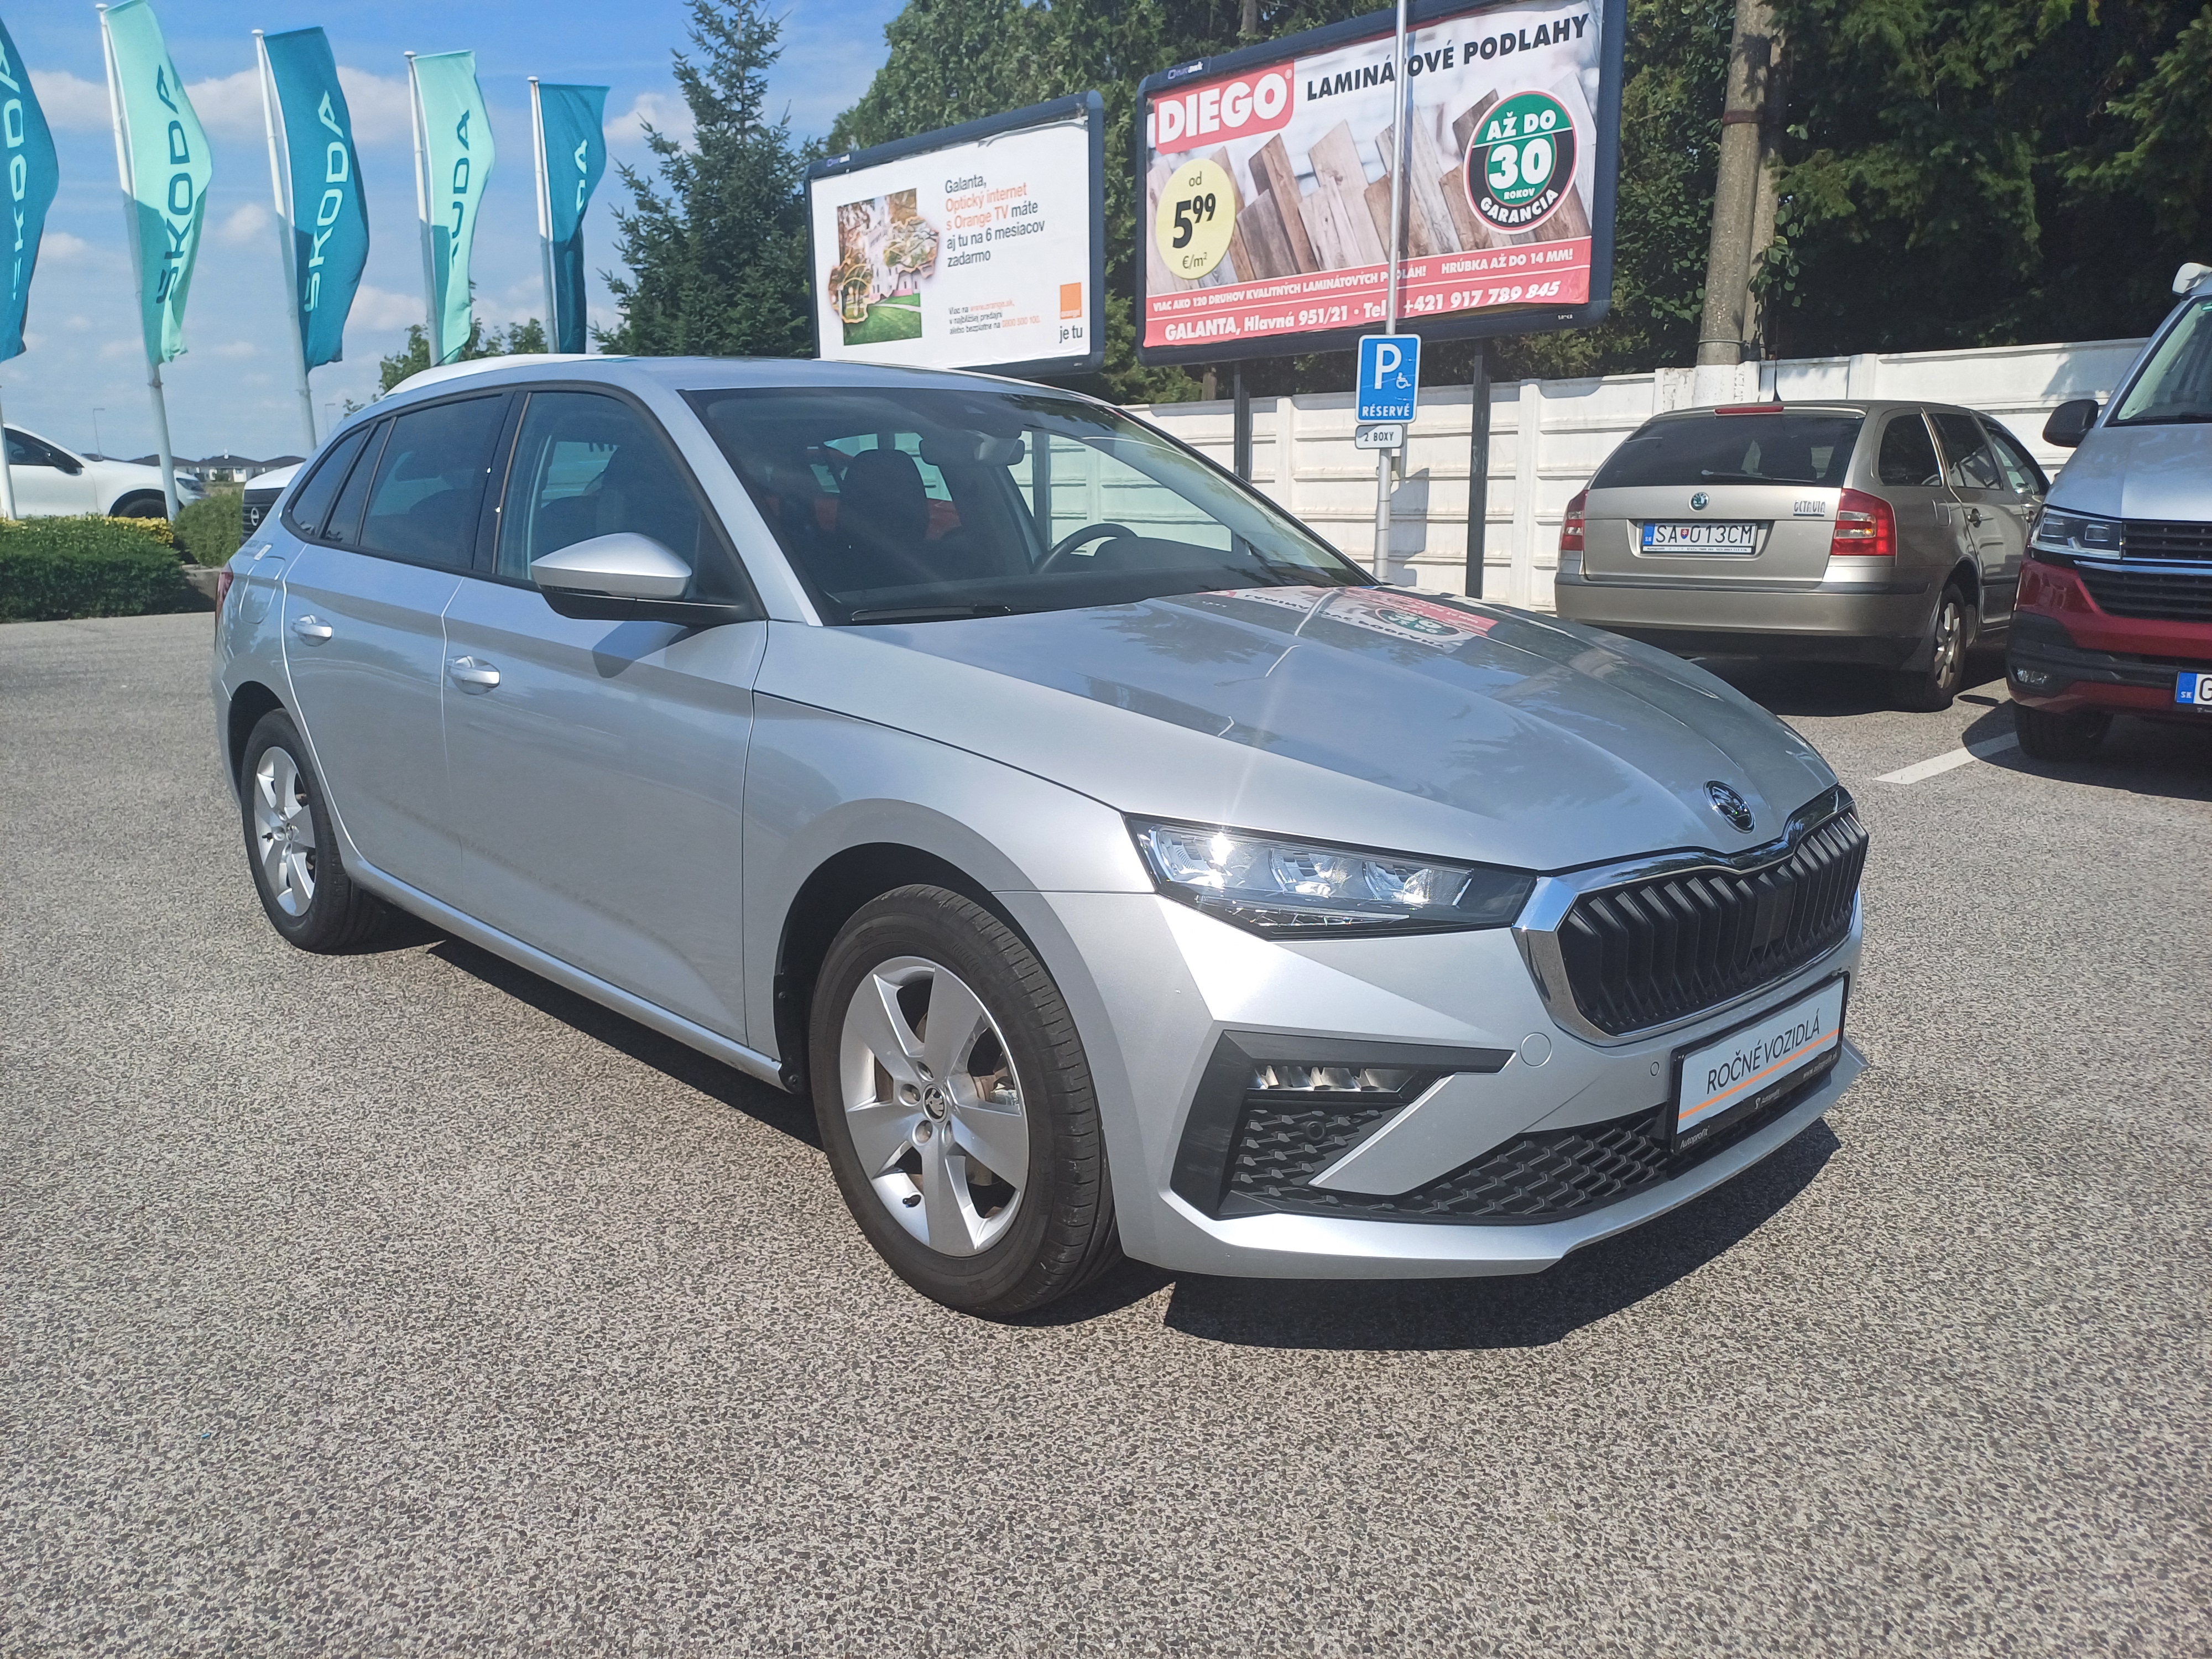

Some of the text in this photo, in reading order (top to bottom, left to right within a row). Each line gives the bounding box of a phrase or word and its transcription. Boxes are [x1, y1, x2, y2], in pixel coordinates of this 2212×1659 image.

[1307, 13, 1589, 101] LAMINÁOVÉ PODLAHY
[1158, 72, 1288, 144] DIEGO
[1486, 109, 1557, 141] AŽ DO
[1188, 170, 1202, 187] od
[1489, 138, 1552, 189] 30
[945, 174, 987, 194] Galanta,
[946, 182, 1027, 214] Optický internet
[1504, 187, 1536, 200] ROKOV
[946, 200, 1039, 231] s Orange TV máte
[1480, 189, 1559, 223] GARANCIA
[947, 221, 1045, 252] aj tu na 6 mesiacov
[947, 251, 991, 268] zadarmo
[1153, 300, 1172, 312] VIAC
[1173, 299, 1191, 310] AKO
[1193, 296, 1207, 307] 120
[1208, 291, 1245, 305] DRUHOV
[1246, 281, 1301, 300] KVALITNÝCH
[1303, 270, 1378, 293] LAMINÁTOVÝCH
[1441, 257, 1489, 274] HRÚBKA
[1490, 253, 1507, 269] AŽ
[1509, 254, 1526, 267] DO
[1530, 252, 1545, 264] 14
[1546, 248, 1573, 263] MM!
[1165, 316, 1241, 341] GALANTA,
[1244, 311, 1295, 332] Hlavná
[1298, 305, 1348, 326] 951/21
[1403, 294, 1444, 314] +421
[1450, 289, 1484, 309] 917
[1487, 285, 1522, 304] 789
[1525, 280, 1561, 299] 845
[1059, 325, 1083, 343] je tu
[1374, 343, 1402, 389] P
[1361, 403, 1410, 417] RÉSERVÉ
[1364, 431, 1394, 442] 2 BOXY
[1707, 1008, 1820, 1095] ROČNÉ VOZIDLÁ
